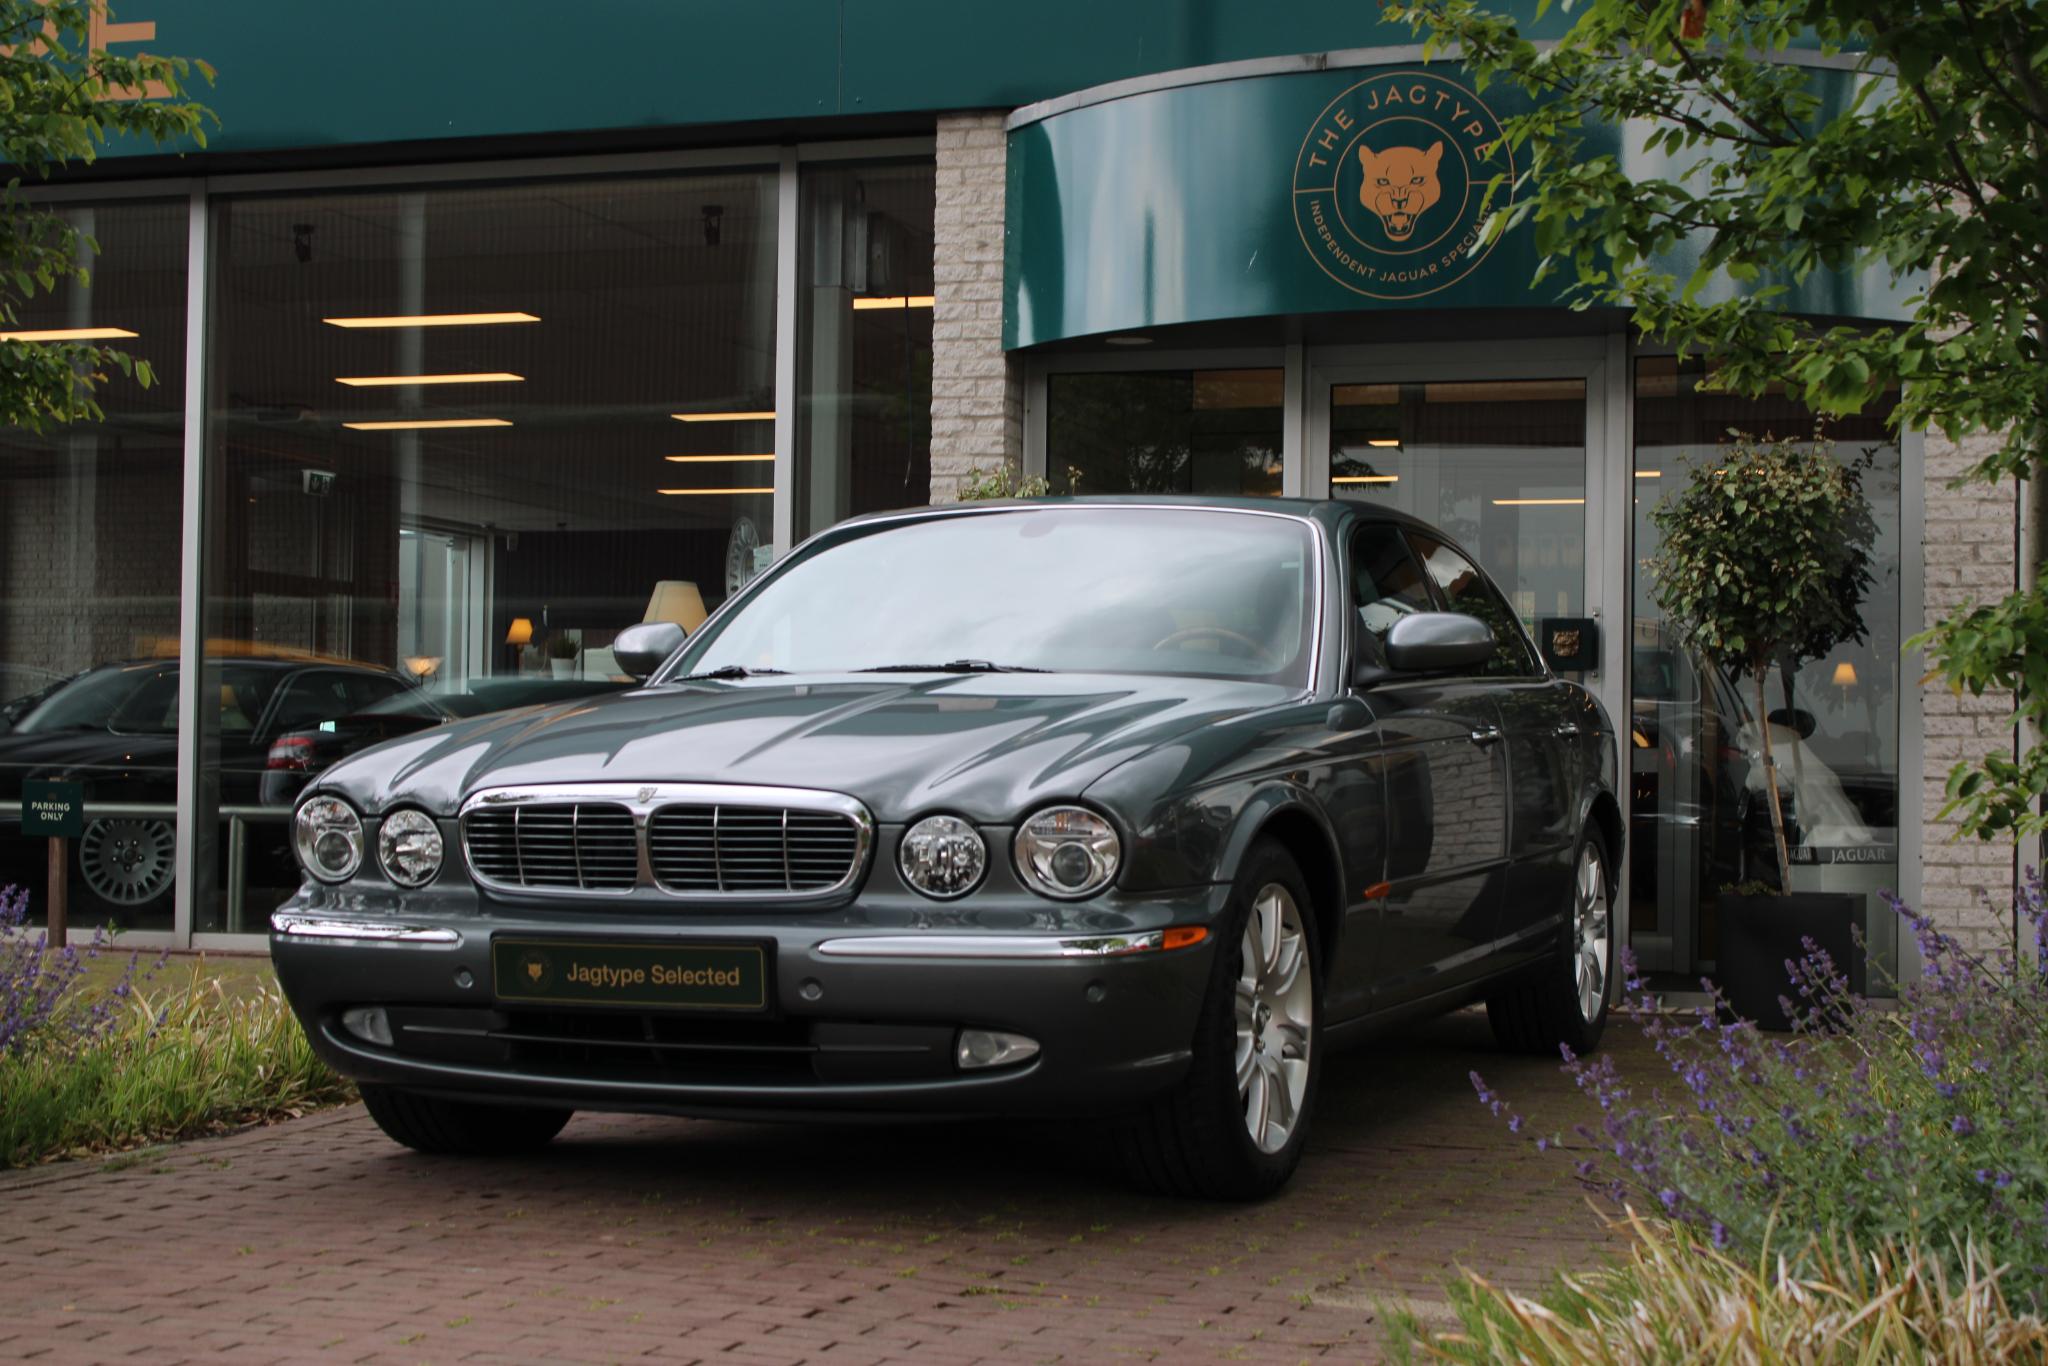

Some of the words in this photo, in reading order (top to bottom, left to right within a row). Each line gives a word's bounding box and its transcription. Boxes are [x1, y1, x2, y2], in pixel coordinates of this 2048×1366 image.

[1309, 108, 1355, 168] THE
[1367, 84, 1493, 161] JAGTYPE
[1310, 200, 1376, 279] INDEPENDENT
[1379, 263, 1438, 282] JAGUAR
[31, 801, 70, 812] PARKING
[40, 811, 64, 821] ONLY
[1830, 848, 1886, 864] JAGUAR
[567, 962, 645, 987] Jagtype
[651, 964, 740, 986] Selected
